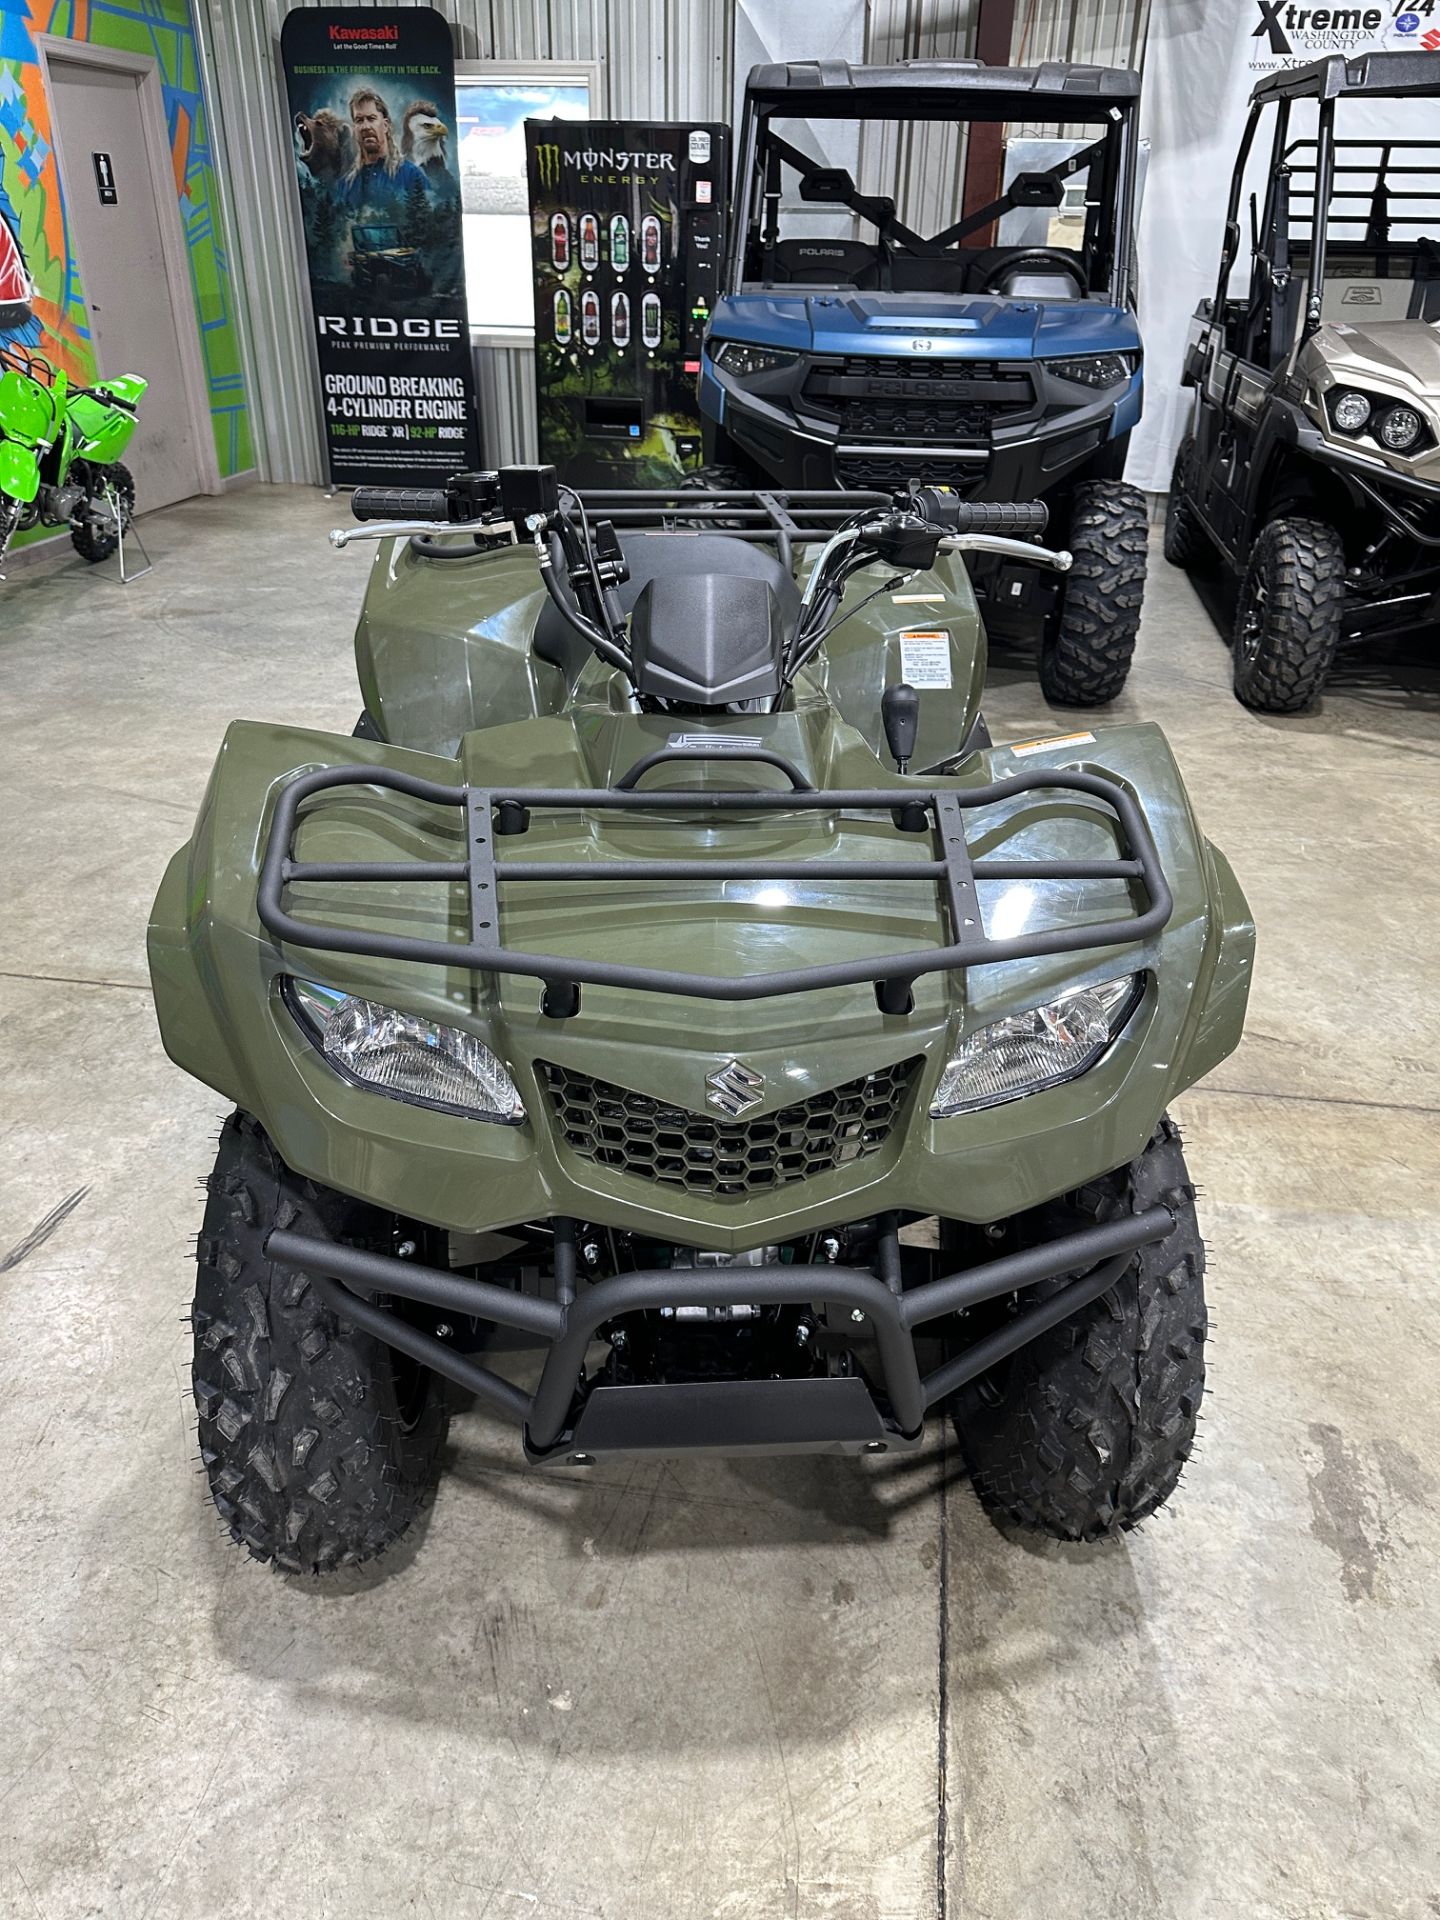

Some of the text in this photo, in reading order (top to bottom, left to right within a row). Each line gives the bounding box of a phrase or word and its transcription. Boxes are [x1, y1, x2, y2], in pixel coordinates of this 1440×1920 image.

[329, 25, 399, 40] Kawasaki
[1251, 0, 1381, 54] Xtreme
[1291, 30, 1376, 40] WASHINGTON
[1305, 40, 1360, 50] COUNTY
[294, 65, 326, 74] BUSINESS
[327, 66, 335, 74] IN
[336, 66, 348, 74] THE
[374, 66, 396, 74] PARTY
[397, 66, 405, 74] IN
[405, 66, 418, 74] THE
[420, 66, 441, 74] BACK.
[564, 148, 676, 172] MONSTER
[581, 175, 659, 185] ENERGY
[799, 248, 845, 257] POLARIS
[318, 315, 461, 338] RIDGE
[331, 340, 450, 352] PEAK PREMIUM PERFORMANCE
[325, 374, 464, 398] GROUND BREAKING
[865, 382, 971, 398] POLARIS
[327, 397, 467, 420] 4-CYLINDER ENGINE
[330, 424, 361, 436] 116-HP
[391, 426, 404, 438] XR
[411, 426, 437, 439] 92-HP
